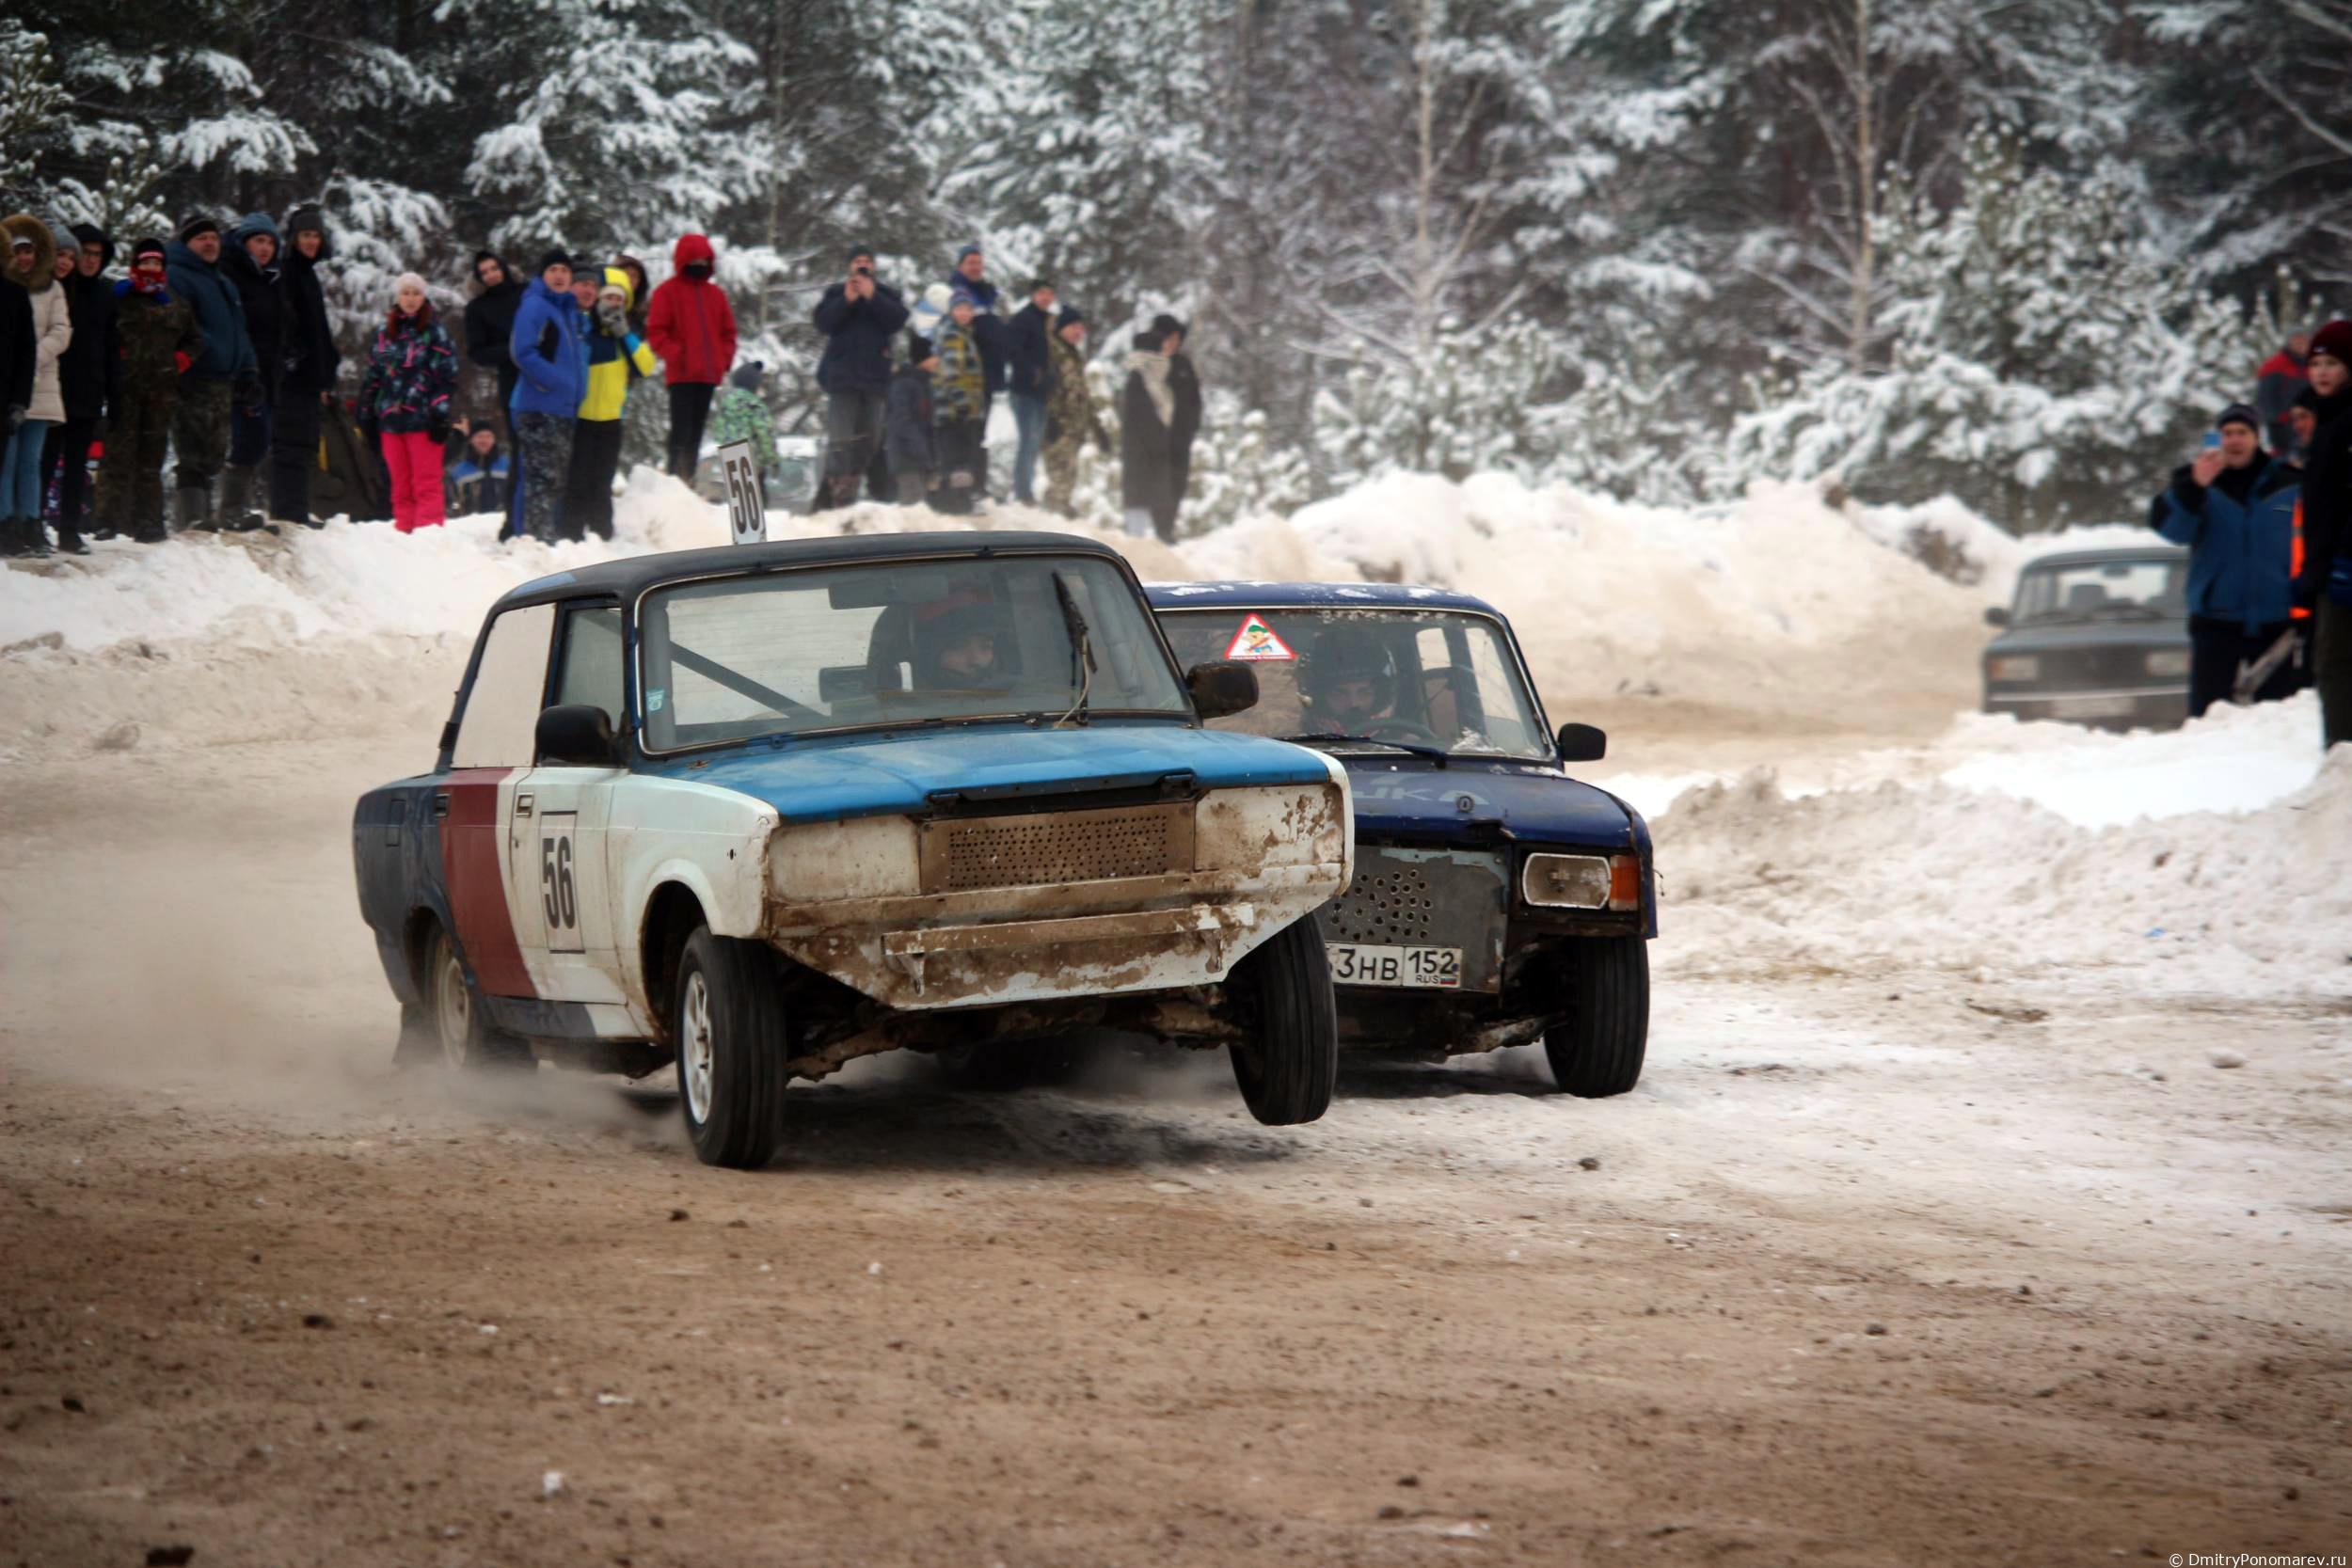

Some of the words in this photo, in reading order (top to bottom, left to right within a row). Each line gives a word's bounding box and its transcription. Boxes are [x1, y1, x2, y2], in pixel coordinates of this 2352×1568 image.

[726, 456, 760, 534] 56
[542, 836, 575, 929] 56
[1327, 947, 1398, 981] 3НВ
[1408, 950, 1454, 974] 152
[1416, 975, 1438, 984] RUS
